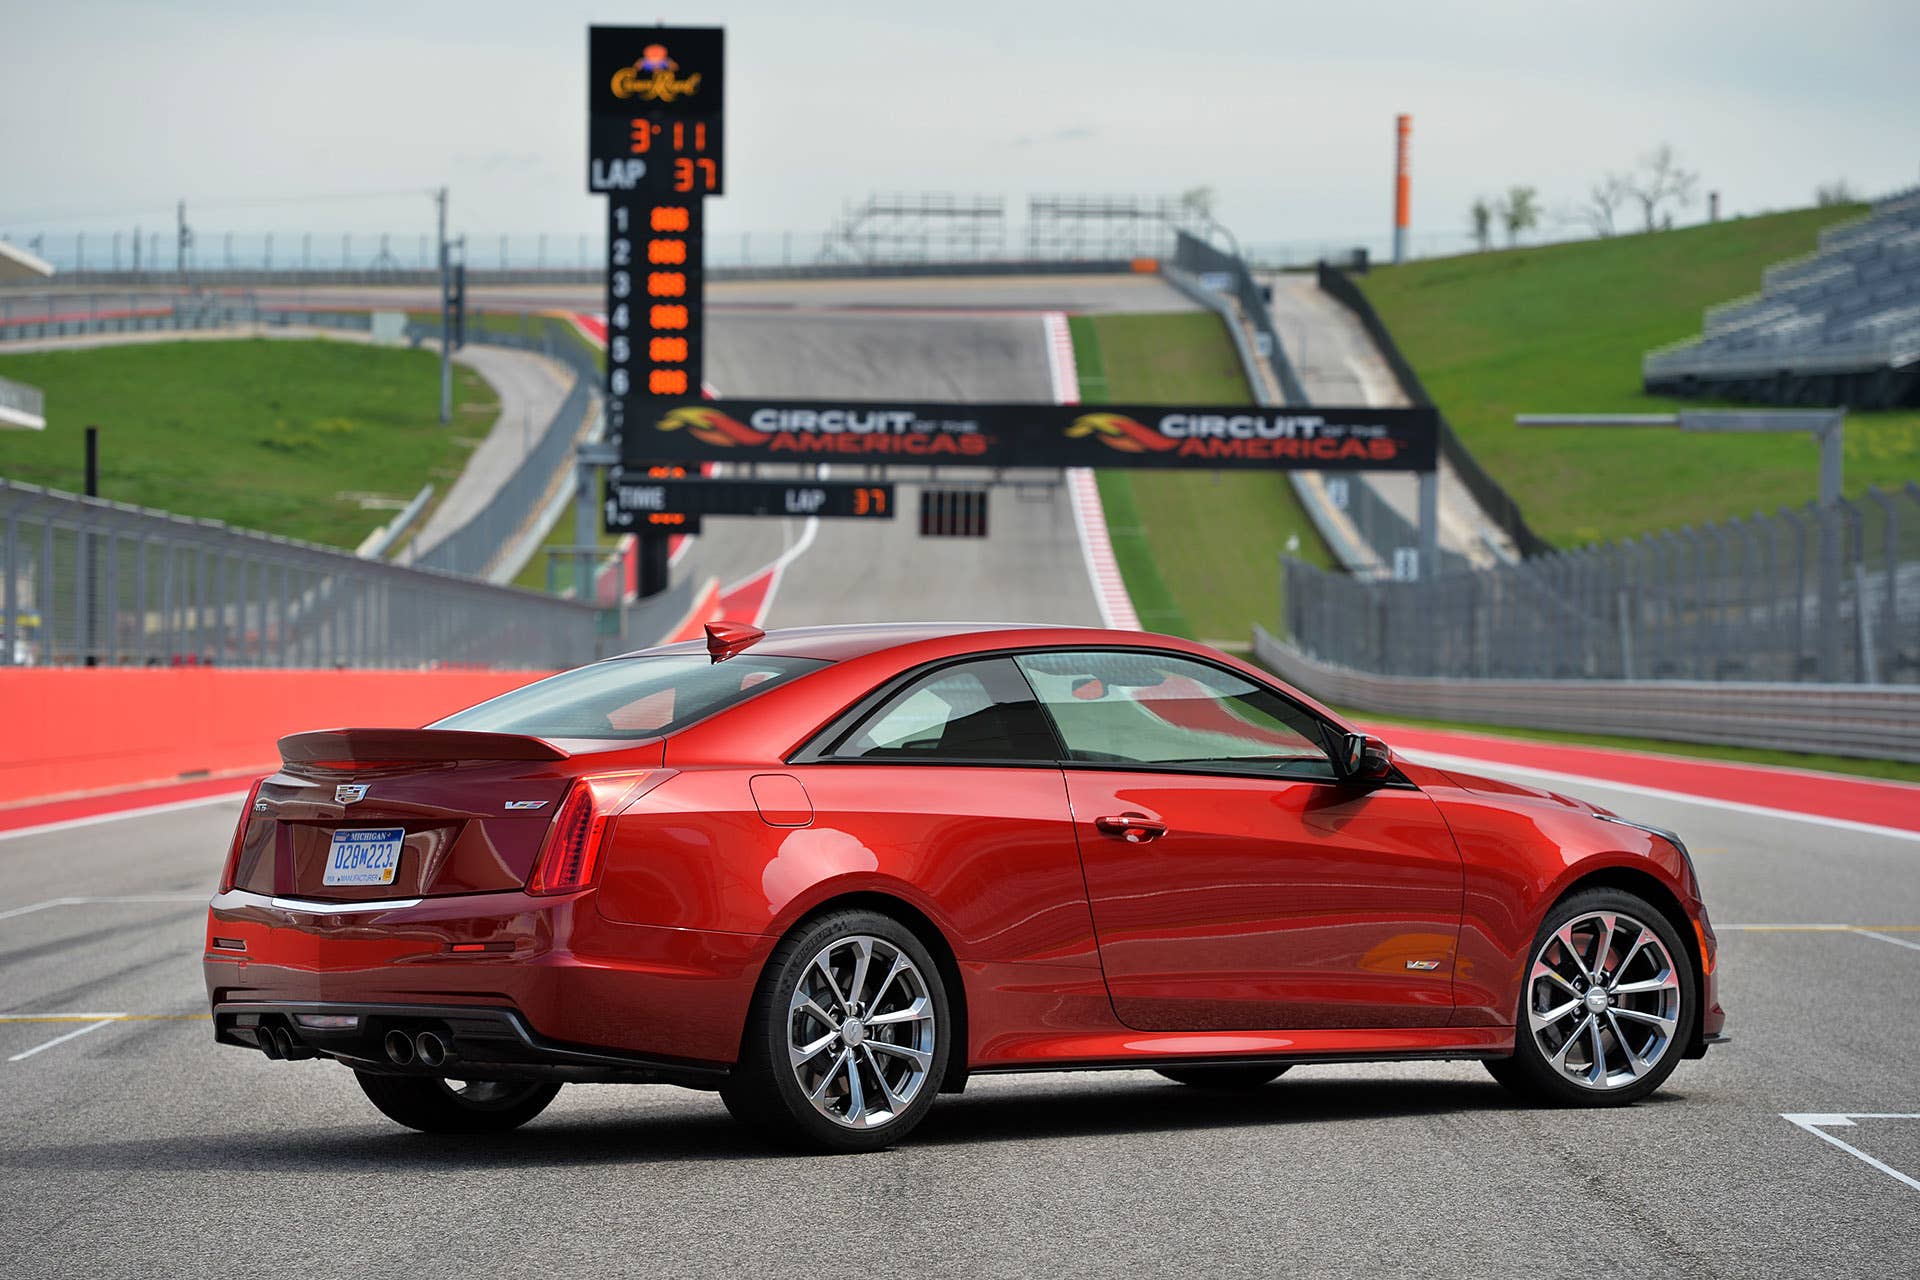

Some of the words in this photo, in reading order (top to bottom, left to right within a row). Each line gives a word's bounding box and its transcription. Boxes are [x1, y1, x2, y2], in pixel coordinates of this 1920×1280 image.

[592, 158, 647, 190] LAP
[673, 157, 717, 192] 37
[614, 206, 629, 232] 1
[612, 238, 631, 266] 2
[612, 270, 631, 298] 3
[611, 303, 630, 330] 4
[750, 408, 916, 434] CIRCUIT
[1159, 413, 1326, 439] CIRCUIT
[769, 432, 987, 456] AMERICAS
[1178, 436, 1397, 460] AMERICAS
[784, 488, 827, 513] LAP
[854, 488, 887, 515] 37
[350, 832, 387, 841] MICHIGAN
[335, 843, 393, 869] 028M223
